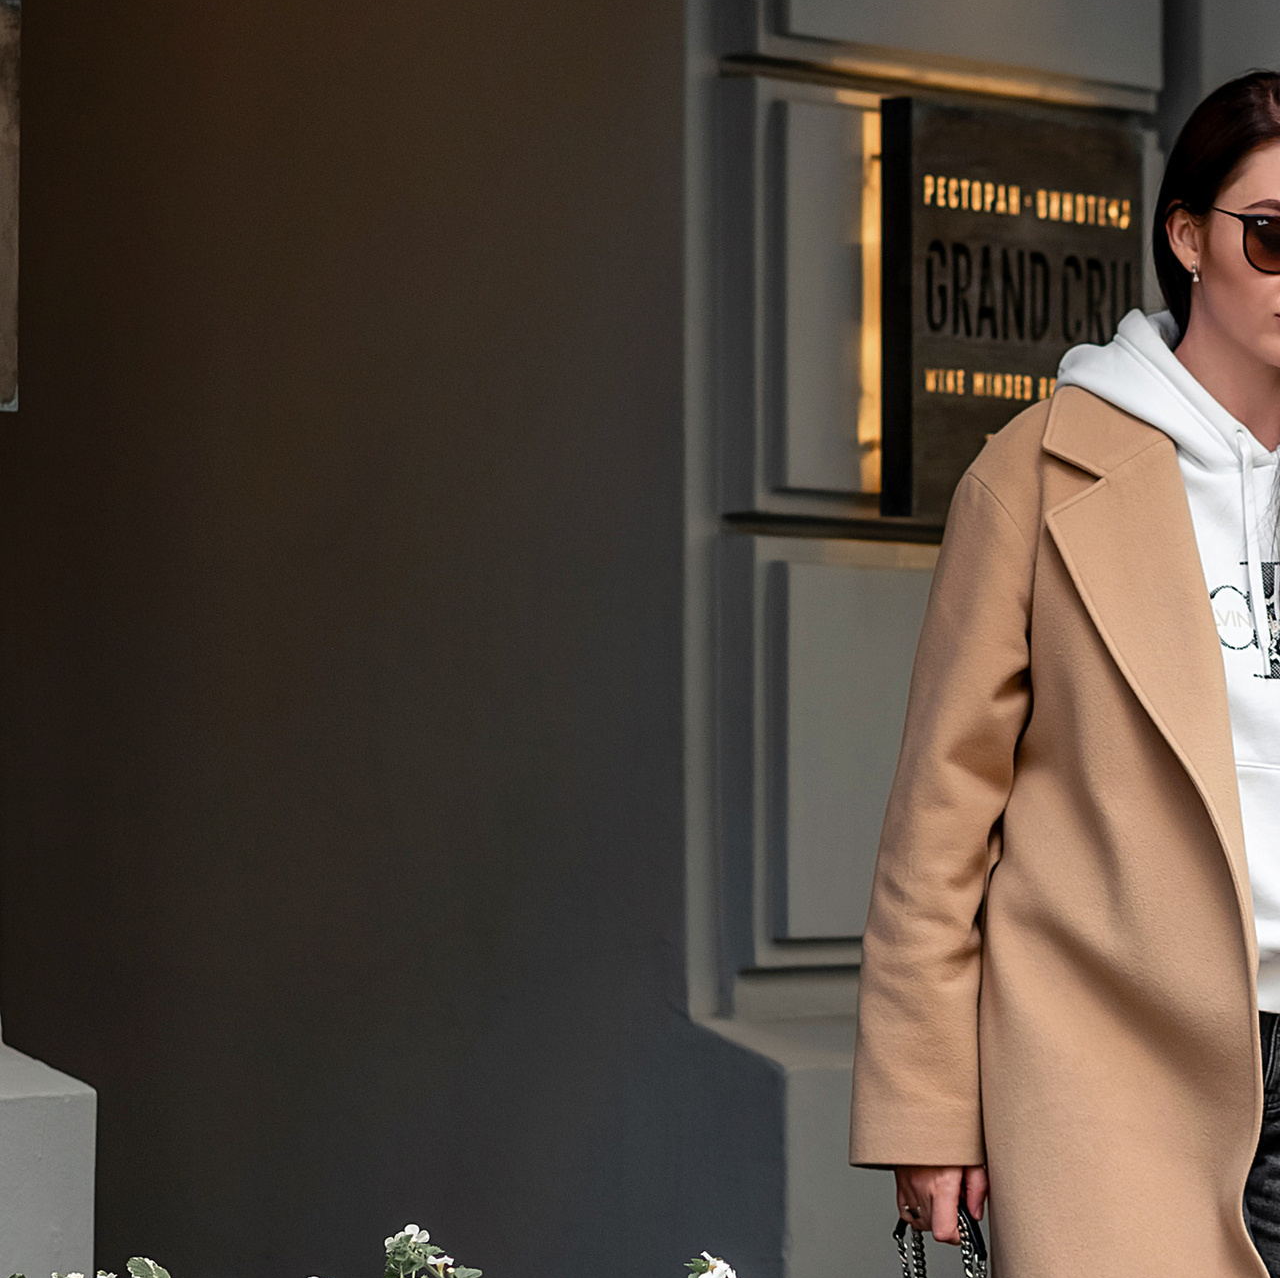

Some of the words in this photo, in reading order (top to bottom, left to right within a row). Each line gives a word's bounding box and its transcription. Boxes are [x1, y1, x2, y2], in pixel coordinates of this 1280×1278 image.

[924, 175, 1020, 216] РЕСТОРАН
[926, 239, 1051, 342] GRAND
[1062, 254, 1132, 347] CRU
